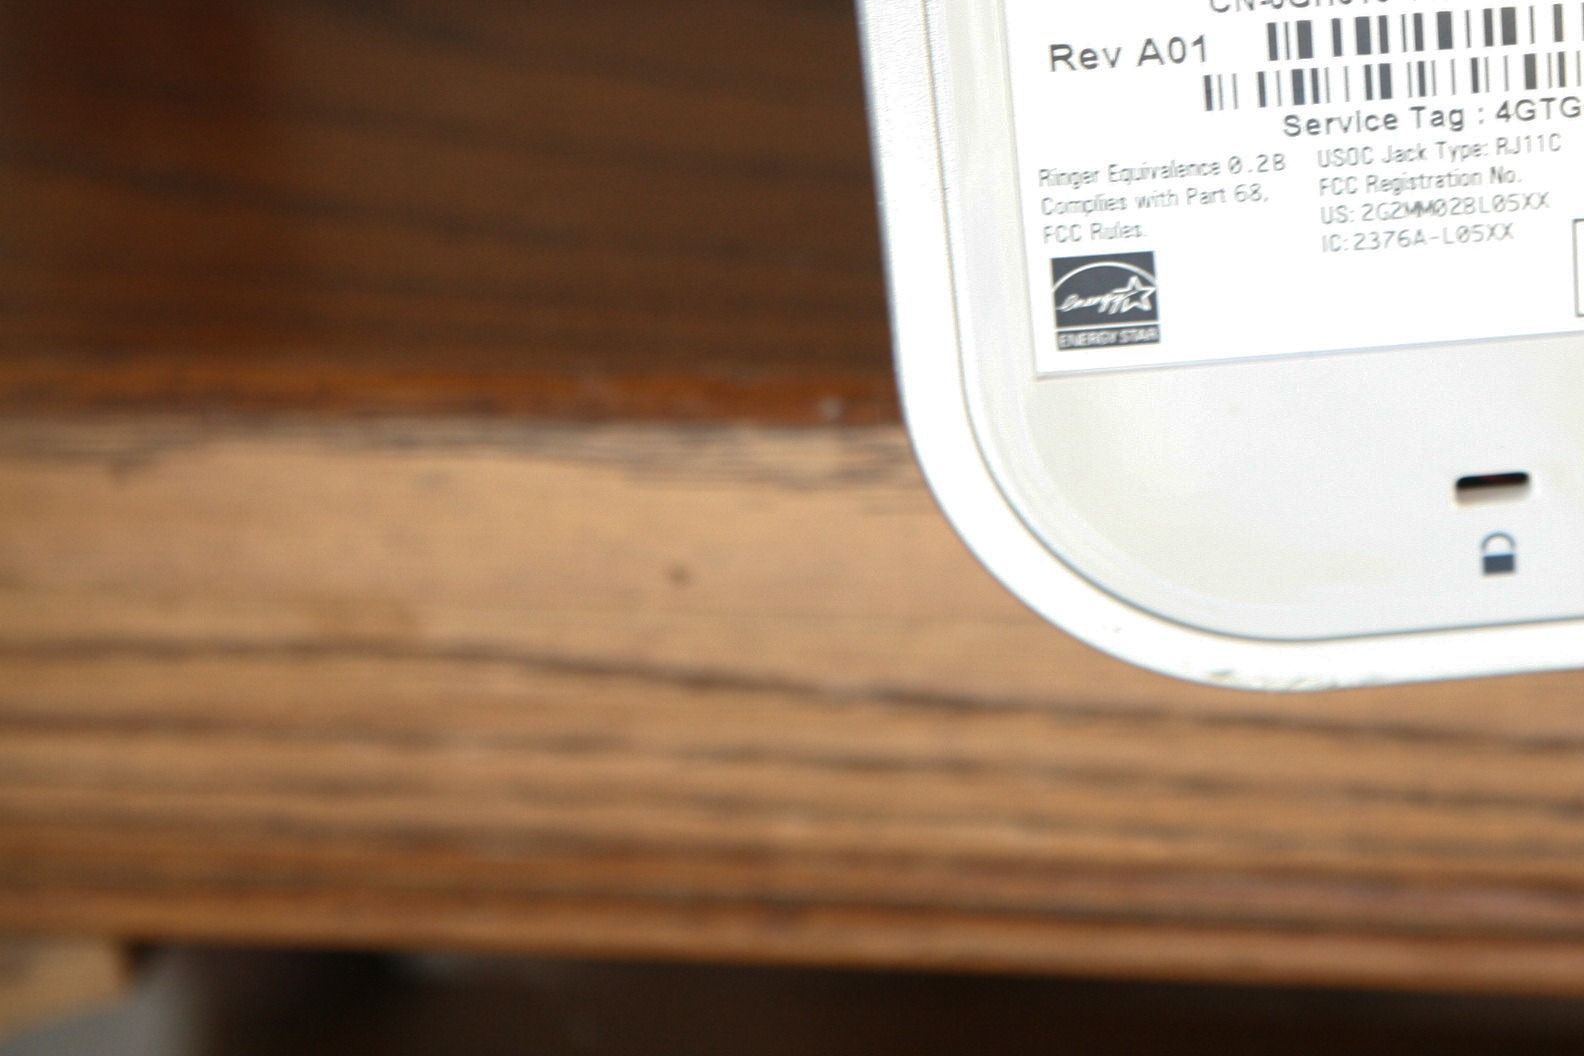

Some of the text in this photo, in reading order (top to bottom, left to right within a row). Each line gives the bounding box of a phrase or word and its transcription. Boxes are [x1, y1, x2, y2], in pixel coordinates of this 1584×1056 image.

[1049, 34, 1207, 72] Rev A01
[1283, 112, 1399, 138] Service
[1411, 103, 1465, 132] Tag
[1317, 133, 1562, 168] USOC Jack Type: RJ11C
[1038, 167, 1100, 190] Ringer
[1108, 159, 1222, 185] Equivalence
[1319, 166, 1523, 196] FCC Registration No.
[1041, 194, 1128, 217] Complies
[1135, 190, 1180, 209] with
[1186, 186, 1227, 206] Part
[1043, 224, 1082, 244] FCC
